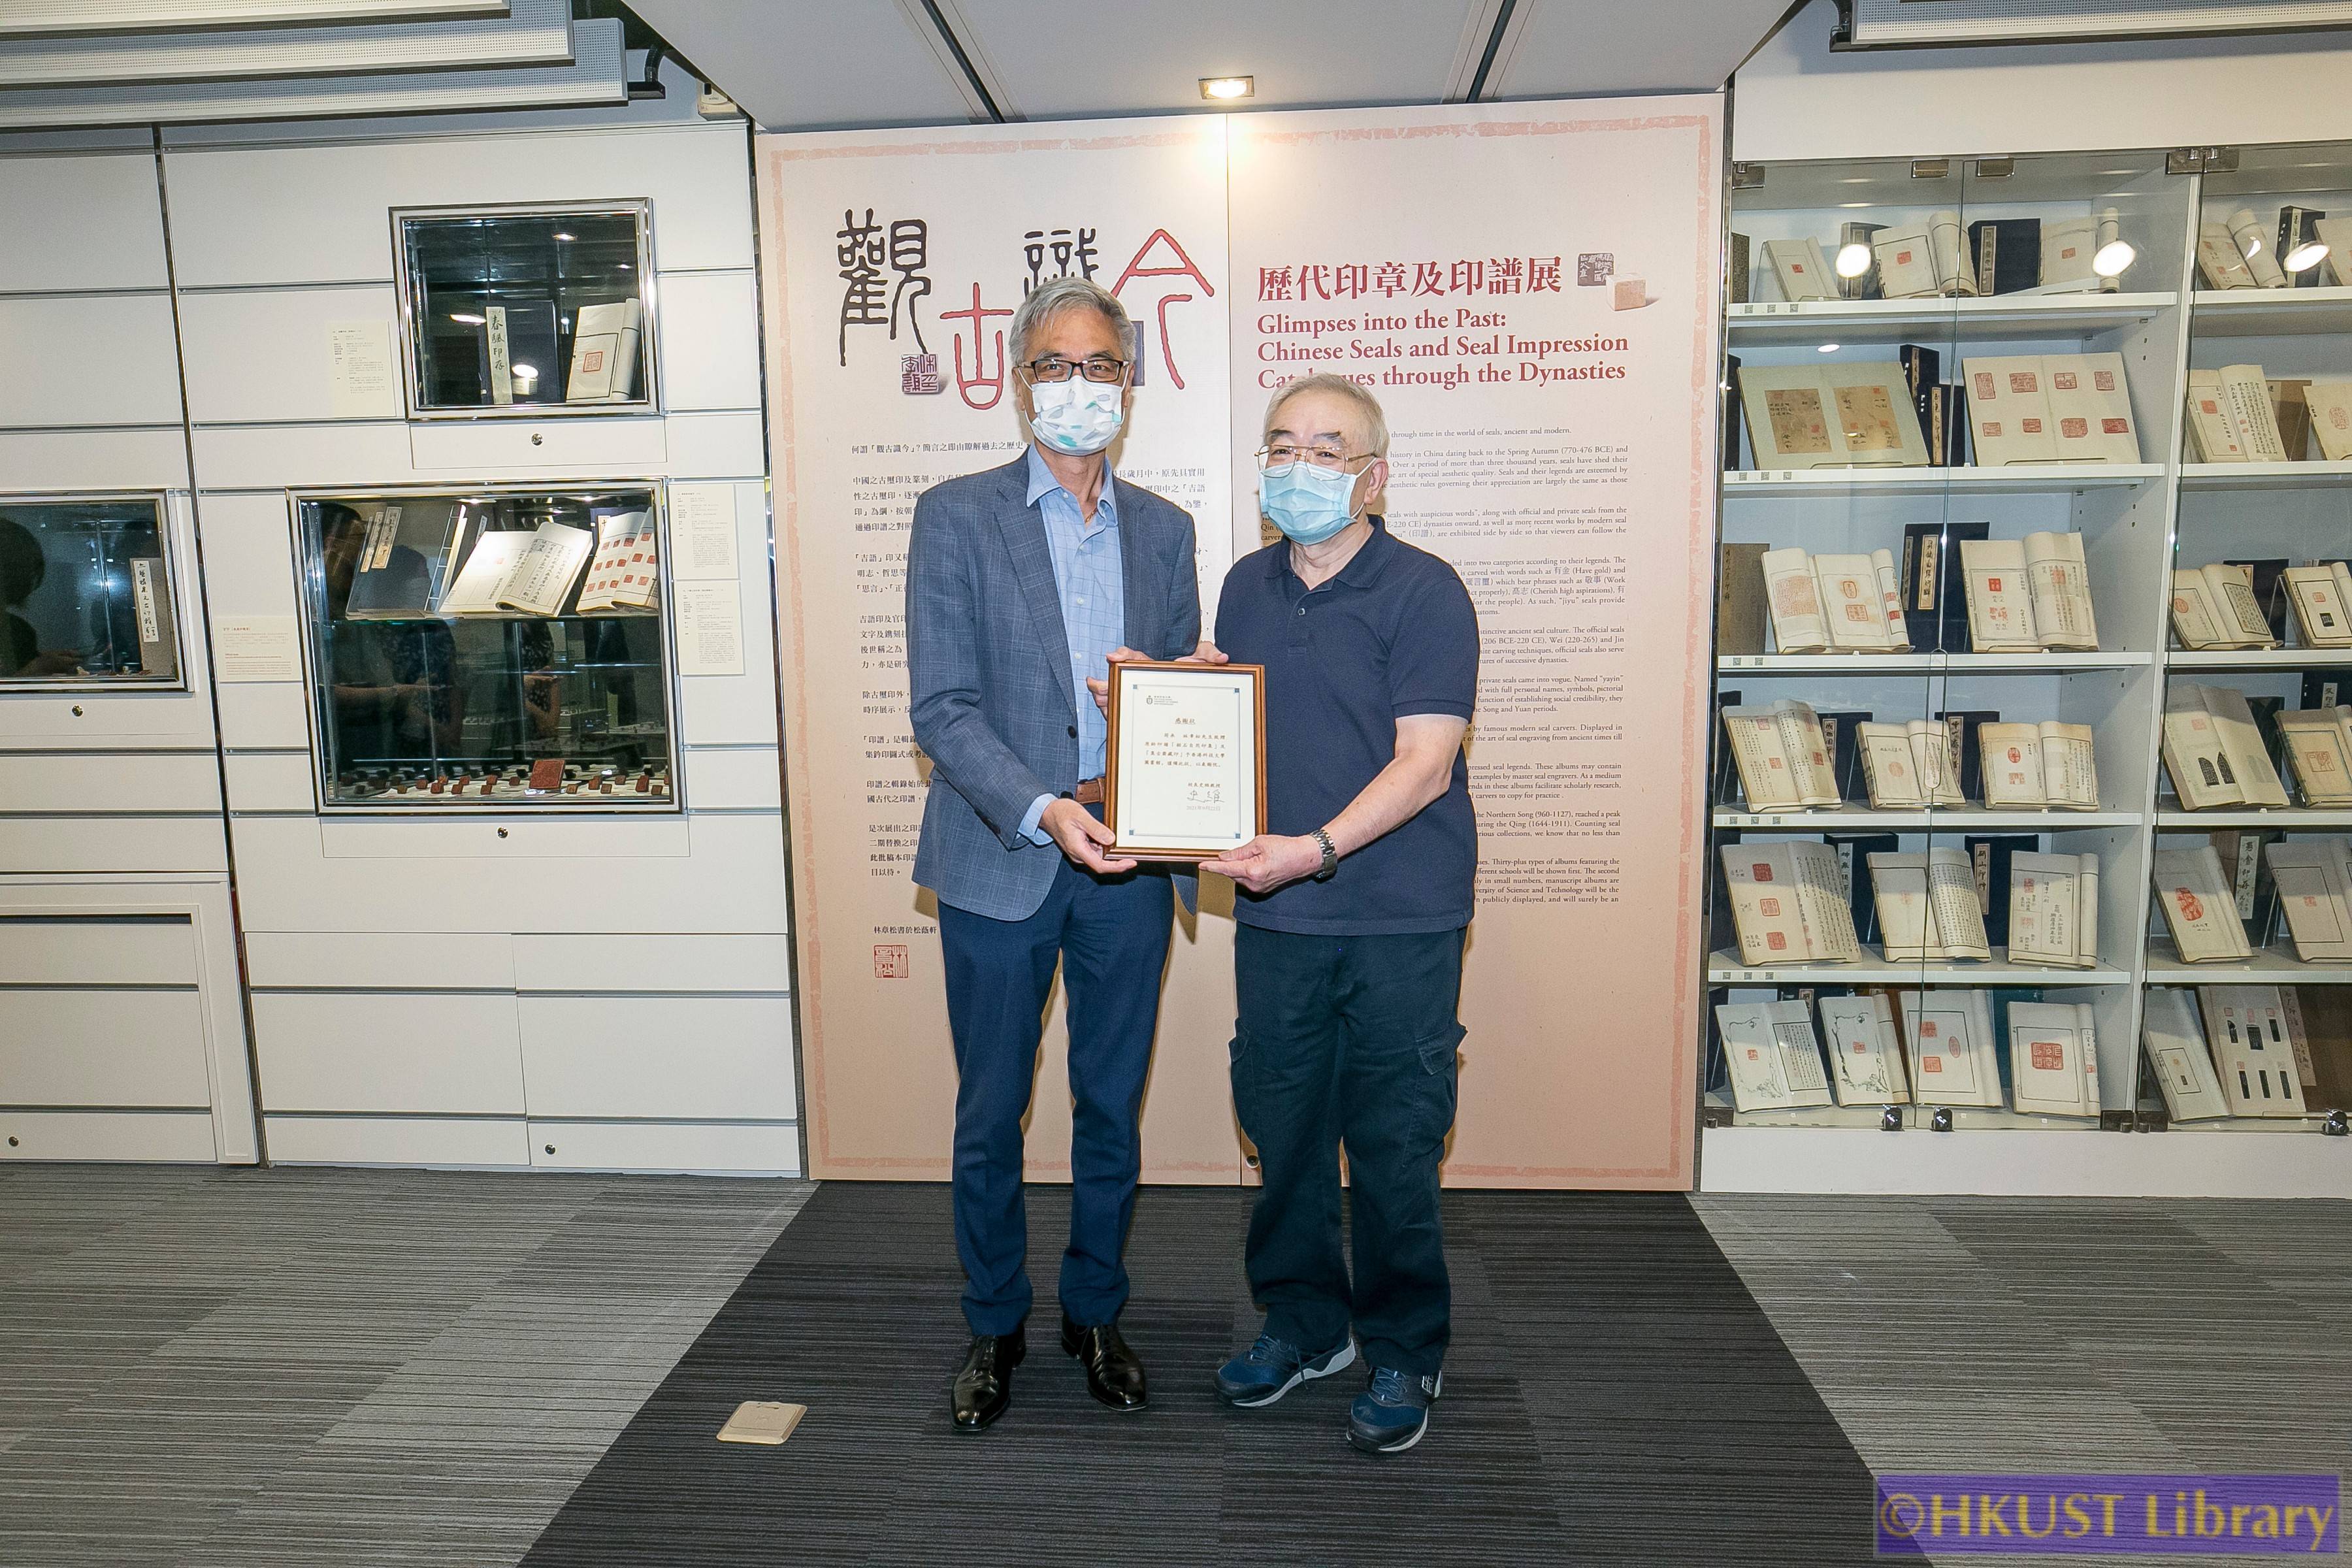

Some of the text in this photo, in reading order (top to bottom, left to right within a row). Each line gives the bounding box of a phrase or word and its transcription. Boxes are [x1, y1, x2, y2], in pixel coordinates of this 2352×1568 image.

[1258, 256, 1562, 302] 歷代印章及印譜展
[1257, 308, 1507, 339] Glimpses into the Past:
[1257, 334, 1629, 362] Chinese Seals and Seal Impression
[1382, 367, 1470, 390] through
[1478, 363, 1512, 384] the
[1520, 361, 1625, 387] Dynasties
[1391, 430, 1417, 440] through
[1390, 450, 1413, 459] history
[1445, 449, 1467, 458] dating
[1507, 447, 1529, 457] Spring
[1595, 445, 1613, 455] BCE)
[1417, 459, 1438, 468] period
[1420, 509, 1453, 519] auspicious
[1482, 508, 1500, 517] along
[1557, 507, 1580, 516] private
[1261, 523, 1274, 532] Qin
[1594, 566, 1611, 575] gold)
[1599, 596, 1625, 606] provide
[1478, 676, 1501, 685] private
[1472, 725, 1481, 734] by
[1580, 724, 1613, 733] Displayed
[1517, 810, 1534, 819] Song
[1605, 809, 1620, 819] peak
[1528, 858, 1544, 866] types
[1579, 857, 1608, 866] featuring
[1482, 895, 1511, 904] publicly
[1578, 895, 1598, 904] surely
